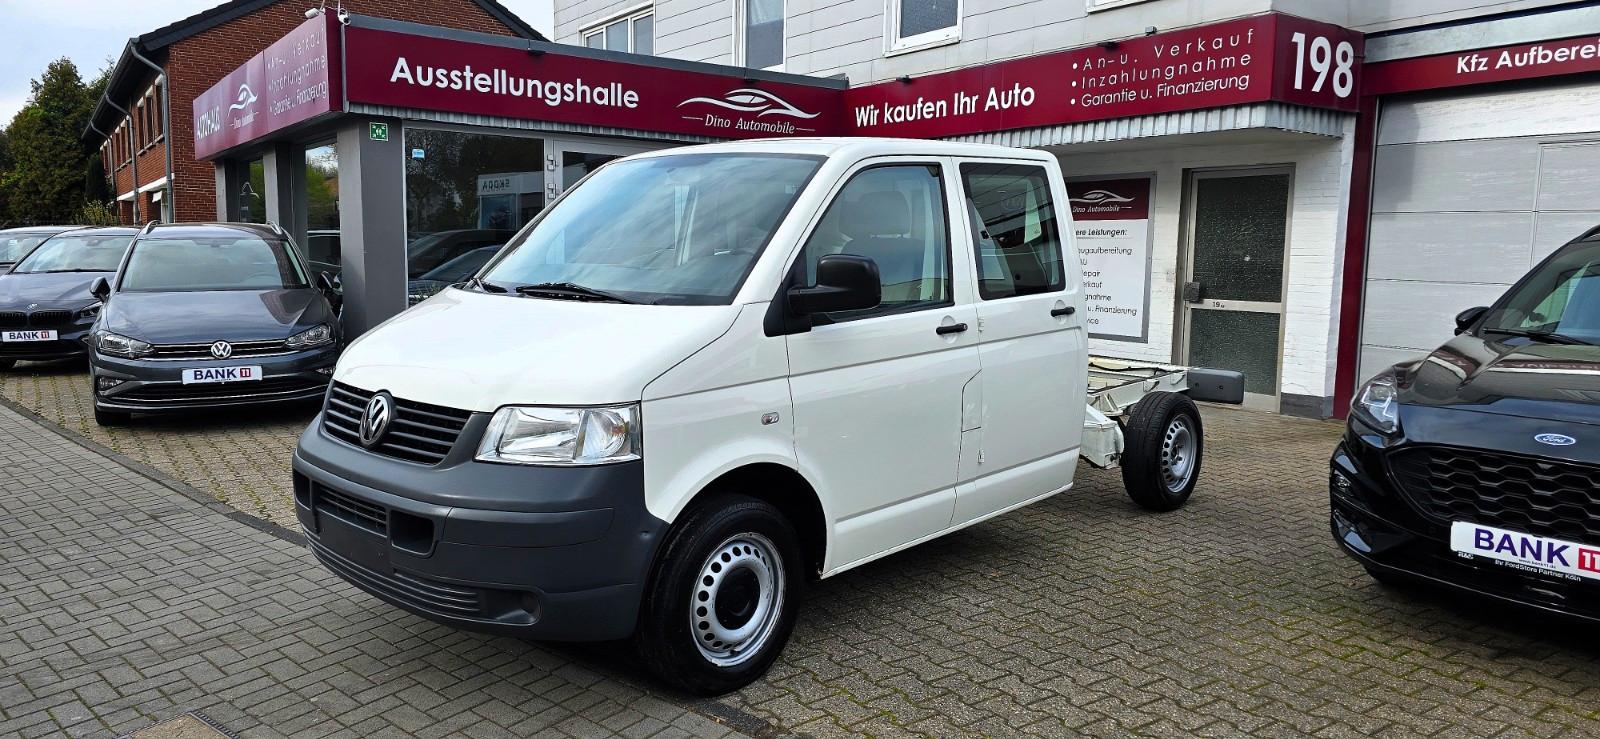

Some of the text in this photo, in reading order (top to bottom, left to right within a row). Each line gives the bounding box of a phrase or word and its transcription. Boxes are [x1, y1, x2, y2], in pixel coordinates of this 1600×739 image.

[1153, 28, 1255, 58] Verkauf
[1081, 53, 1252, 89] Inzahlungnahme
[1291, 31, 1355, 99] 198
[1456, 53, 1489, 74] Kfz
[389, 56, 640, 108] Ausstellungshalle
[1080, 74, 1250, 108] Garantie u. Finanzierung
[855, 82, 1035, 128] Wir kaufen Ihr Auto
[704, 113, 796, 134] Dino Automobile
[1072, 204, 1120, 214] Dino Automobile
[1088, 228, 1128, 238] Leistungen:
[1082, 270, 1101, 278] epair
[1095, 304, 1138, 316] Finanzierung
[9, 331, 39, 340] BANK
[193, 369, 237, 380] BANK
[1473, 527, 1571, 567] BANK
[1538, 567, 1564, 578] Partner
